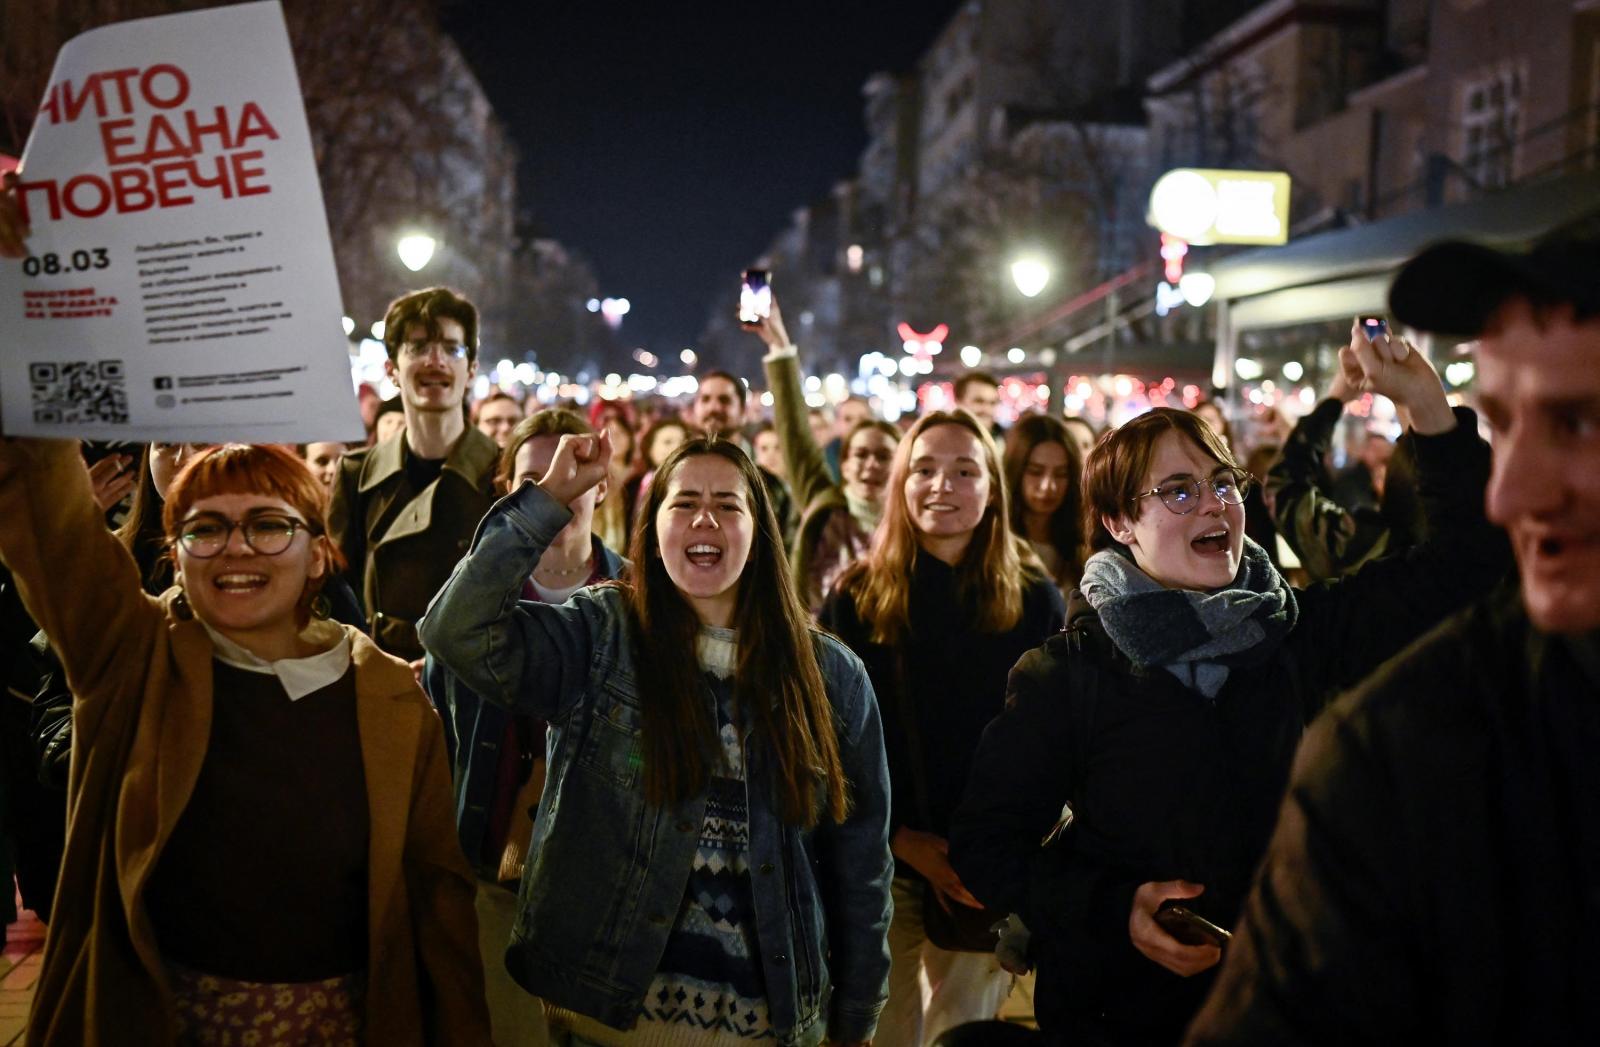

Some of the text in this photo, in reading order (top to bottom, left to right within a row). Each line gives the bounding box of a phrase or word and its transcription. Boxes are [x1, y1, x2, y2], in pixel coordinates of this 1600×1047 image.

[99, 101, 281, 167] ЕДНА
[17, 150, 272, 225] ПОВЕЧЕ
[22, 248, 110, 277] 08.03
